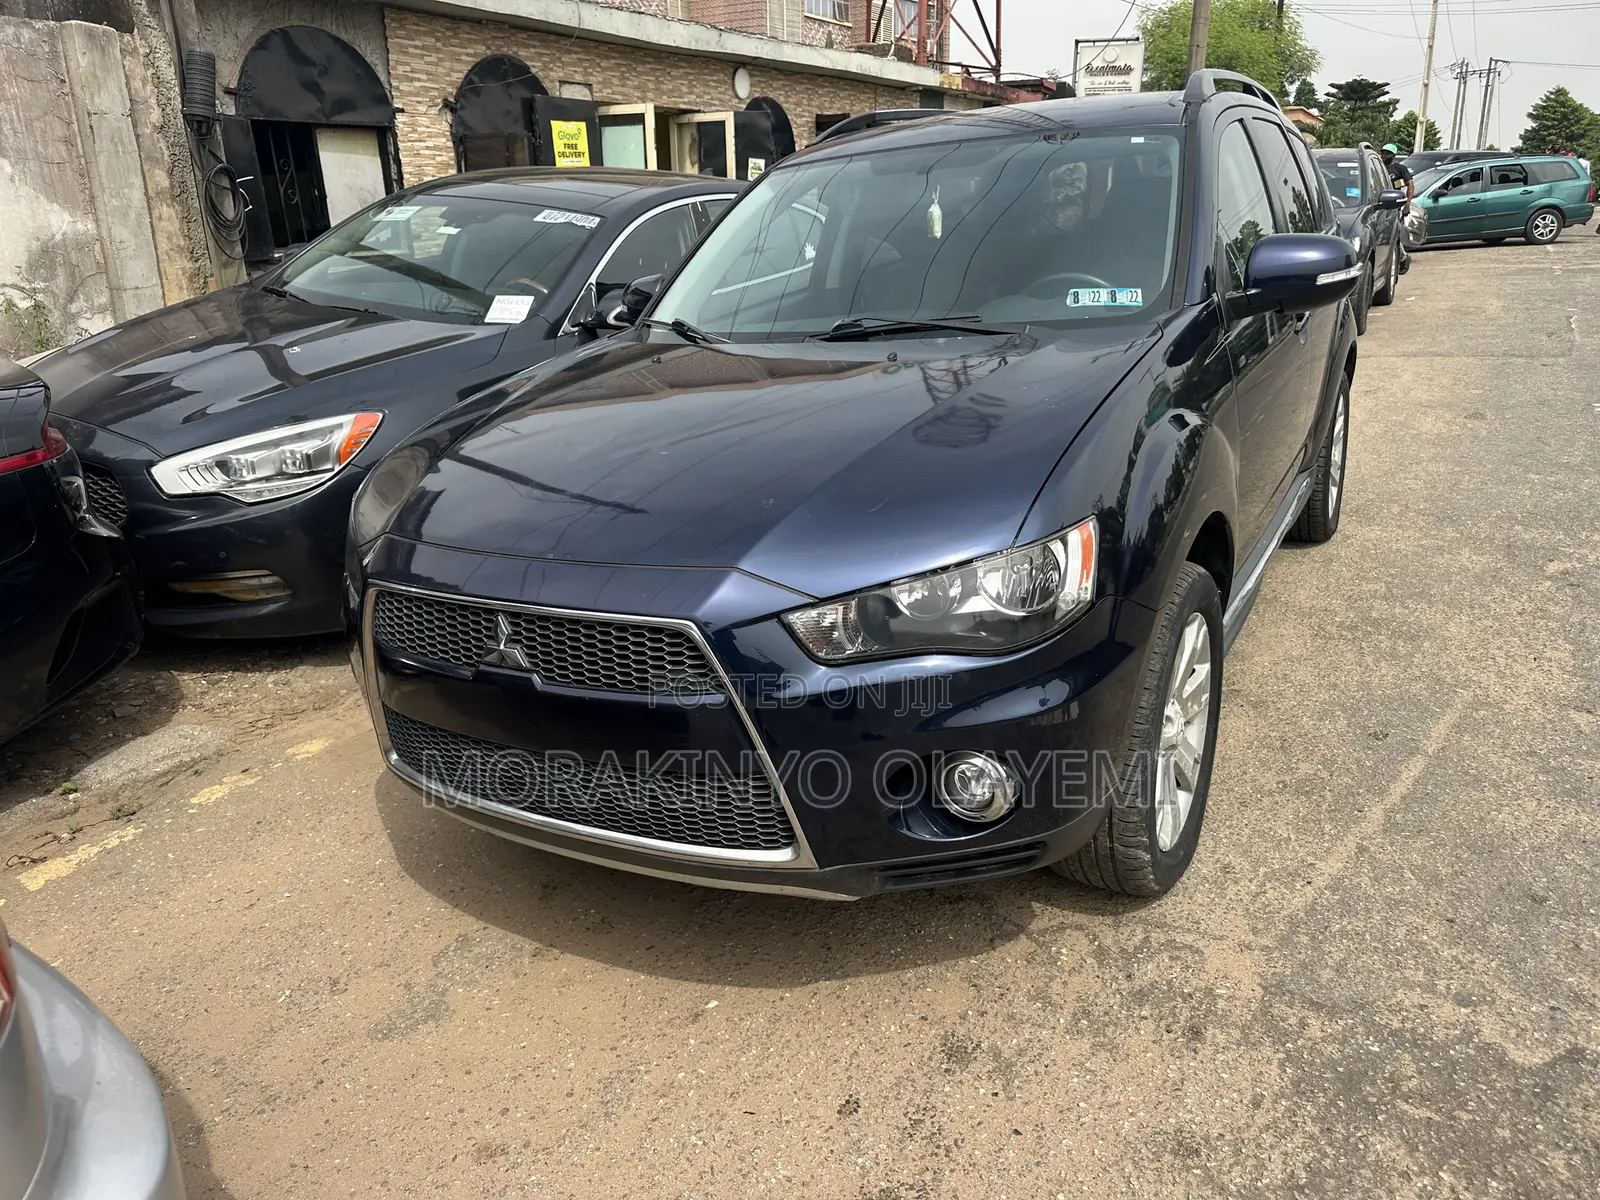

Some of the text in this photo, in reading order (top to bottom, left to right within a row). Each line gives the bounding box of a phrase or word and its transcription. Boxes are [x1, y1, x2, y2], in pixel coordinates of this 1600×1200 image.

[558, 129, 580, 141] Glovo
[563, 143, 579, 151] FREE
[557, 151, 586, 159] DELIVERY
[1073, 290, 1080, 304] 8
[1091, 290, 1101, 303] 22
[1110, 289, 1117, 303] 8
[1129, 290, 1139, 303] 22
